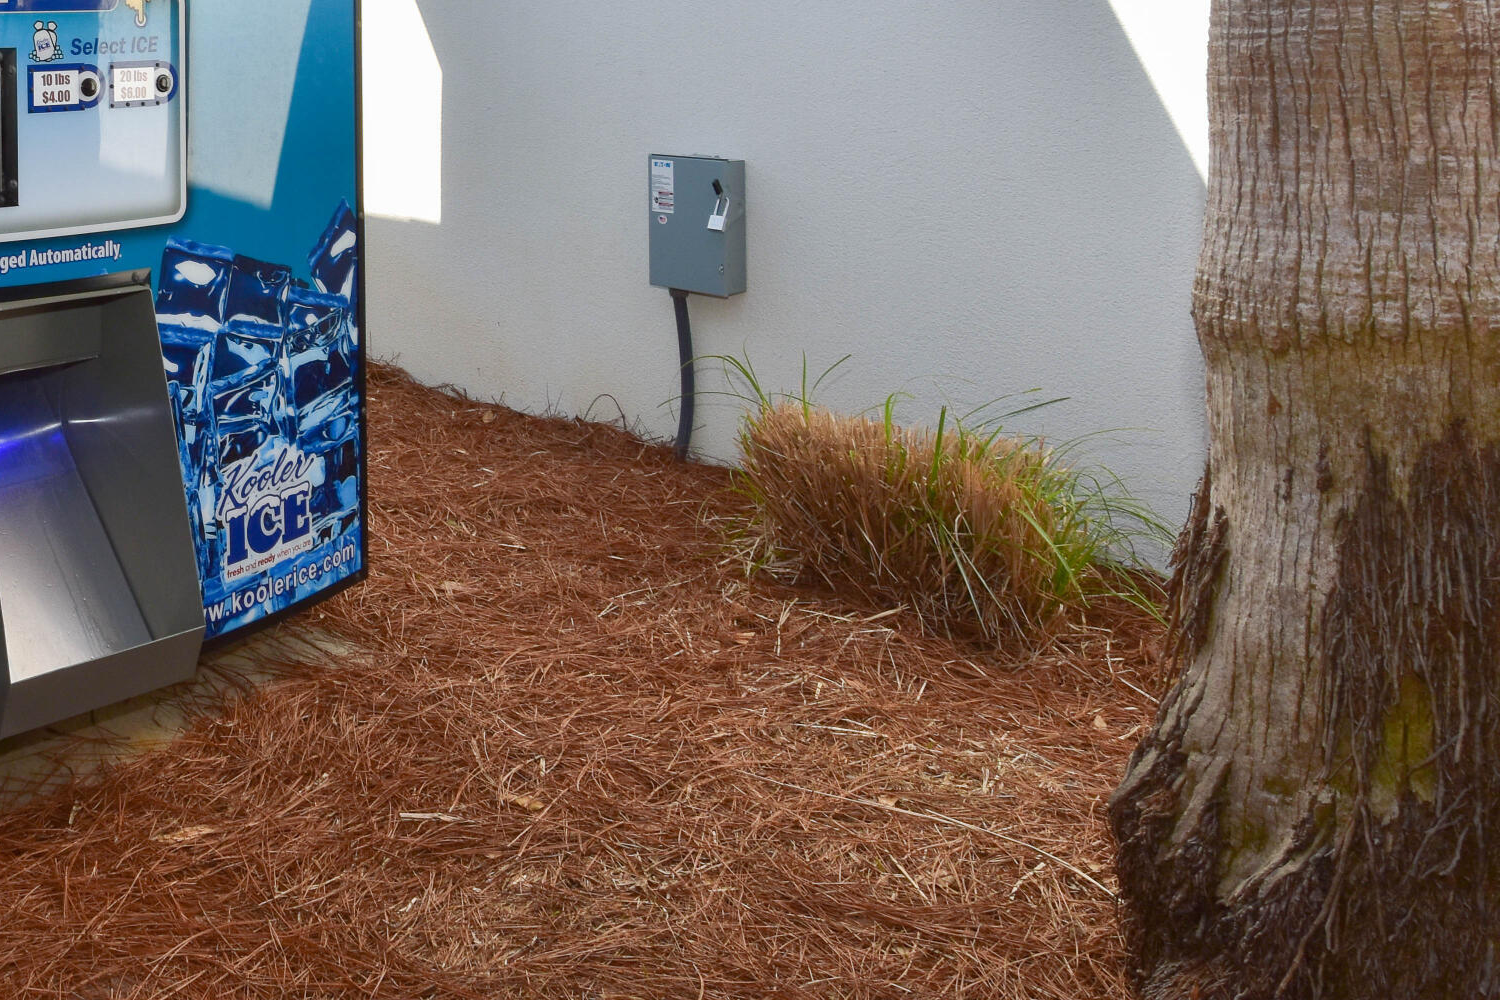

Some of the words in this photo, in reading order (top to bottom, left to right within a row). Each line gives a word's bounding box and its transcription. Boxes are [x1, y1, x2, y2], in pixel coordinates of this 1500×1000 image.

[71, 38, 126, 56] Select
[131, 36, 159, 54] ICE
[41, 74, 53, 87] 10
[55, 73, 71, 85] lbs
[120, 71, 132, 83] 20
[134, 70, 148, 82] lbs
[42, 90, 71, 104] $4.00
[121, 86, 146, 100] $6.00
[29, 240, 123, 268] Automatically.
[218, 448, 315, 516] Kooler
[225, 481, 311, 566] ICE
[227, 566, 244, 579] fresh
[245, 559, 257, 573] and
[258, 553, 276, 570] ready
[277, 548, 291, 559] when
[293, 543, 304, 556] you
[303, 539, 312, 547] are
[204, 544, 355, 622] w.koolerice.com
